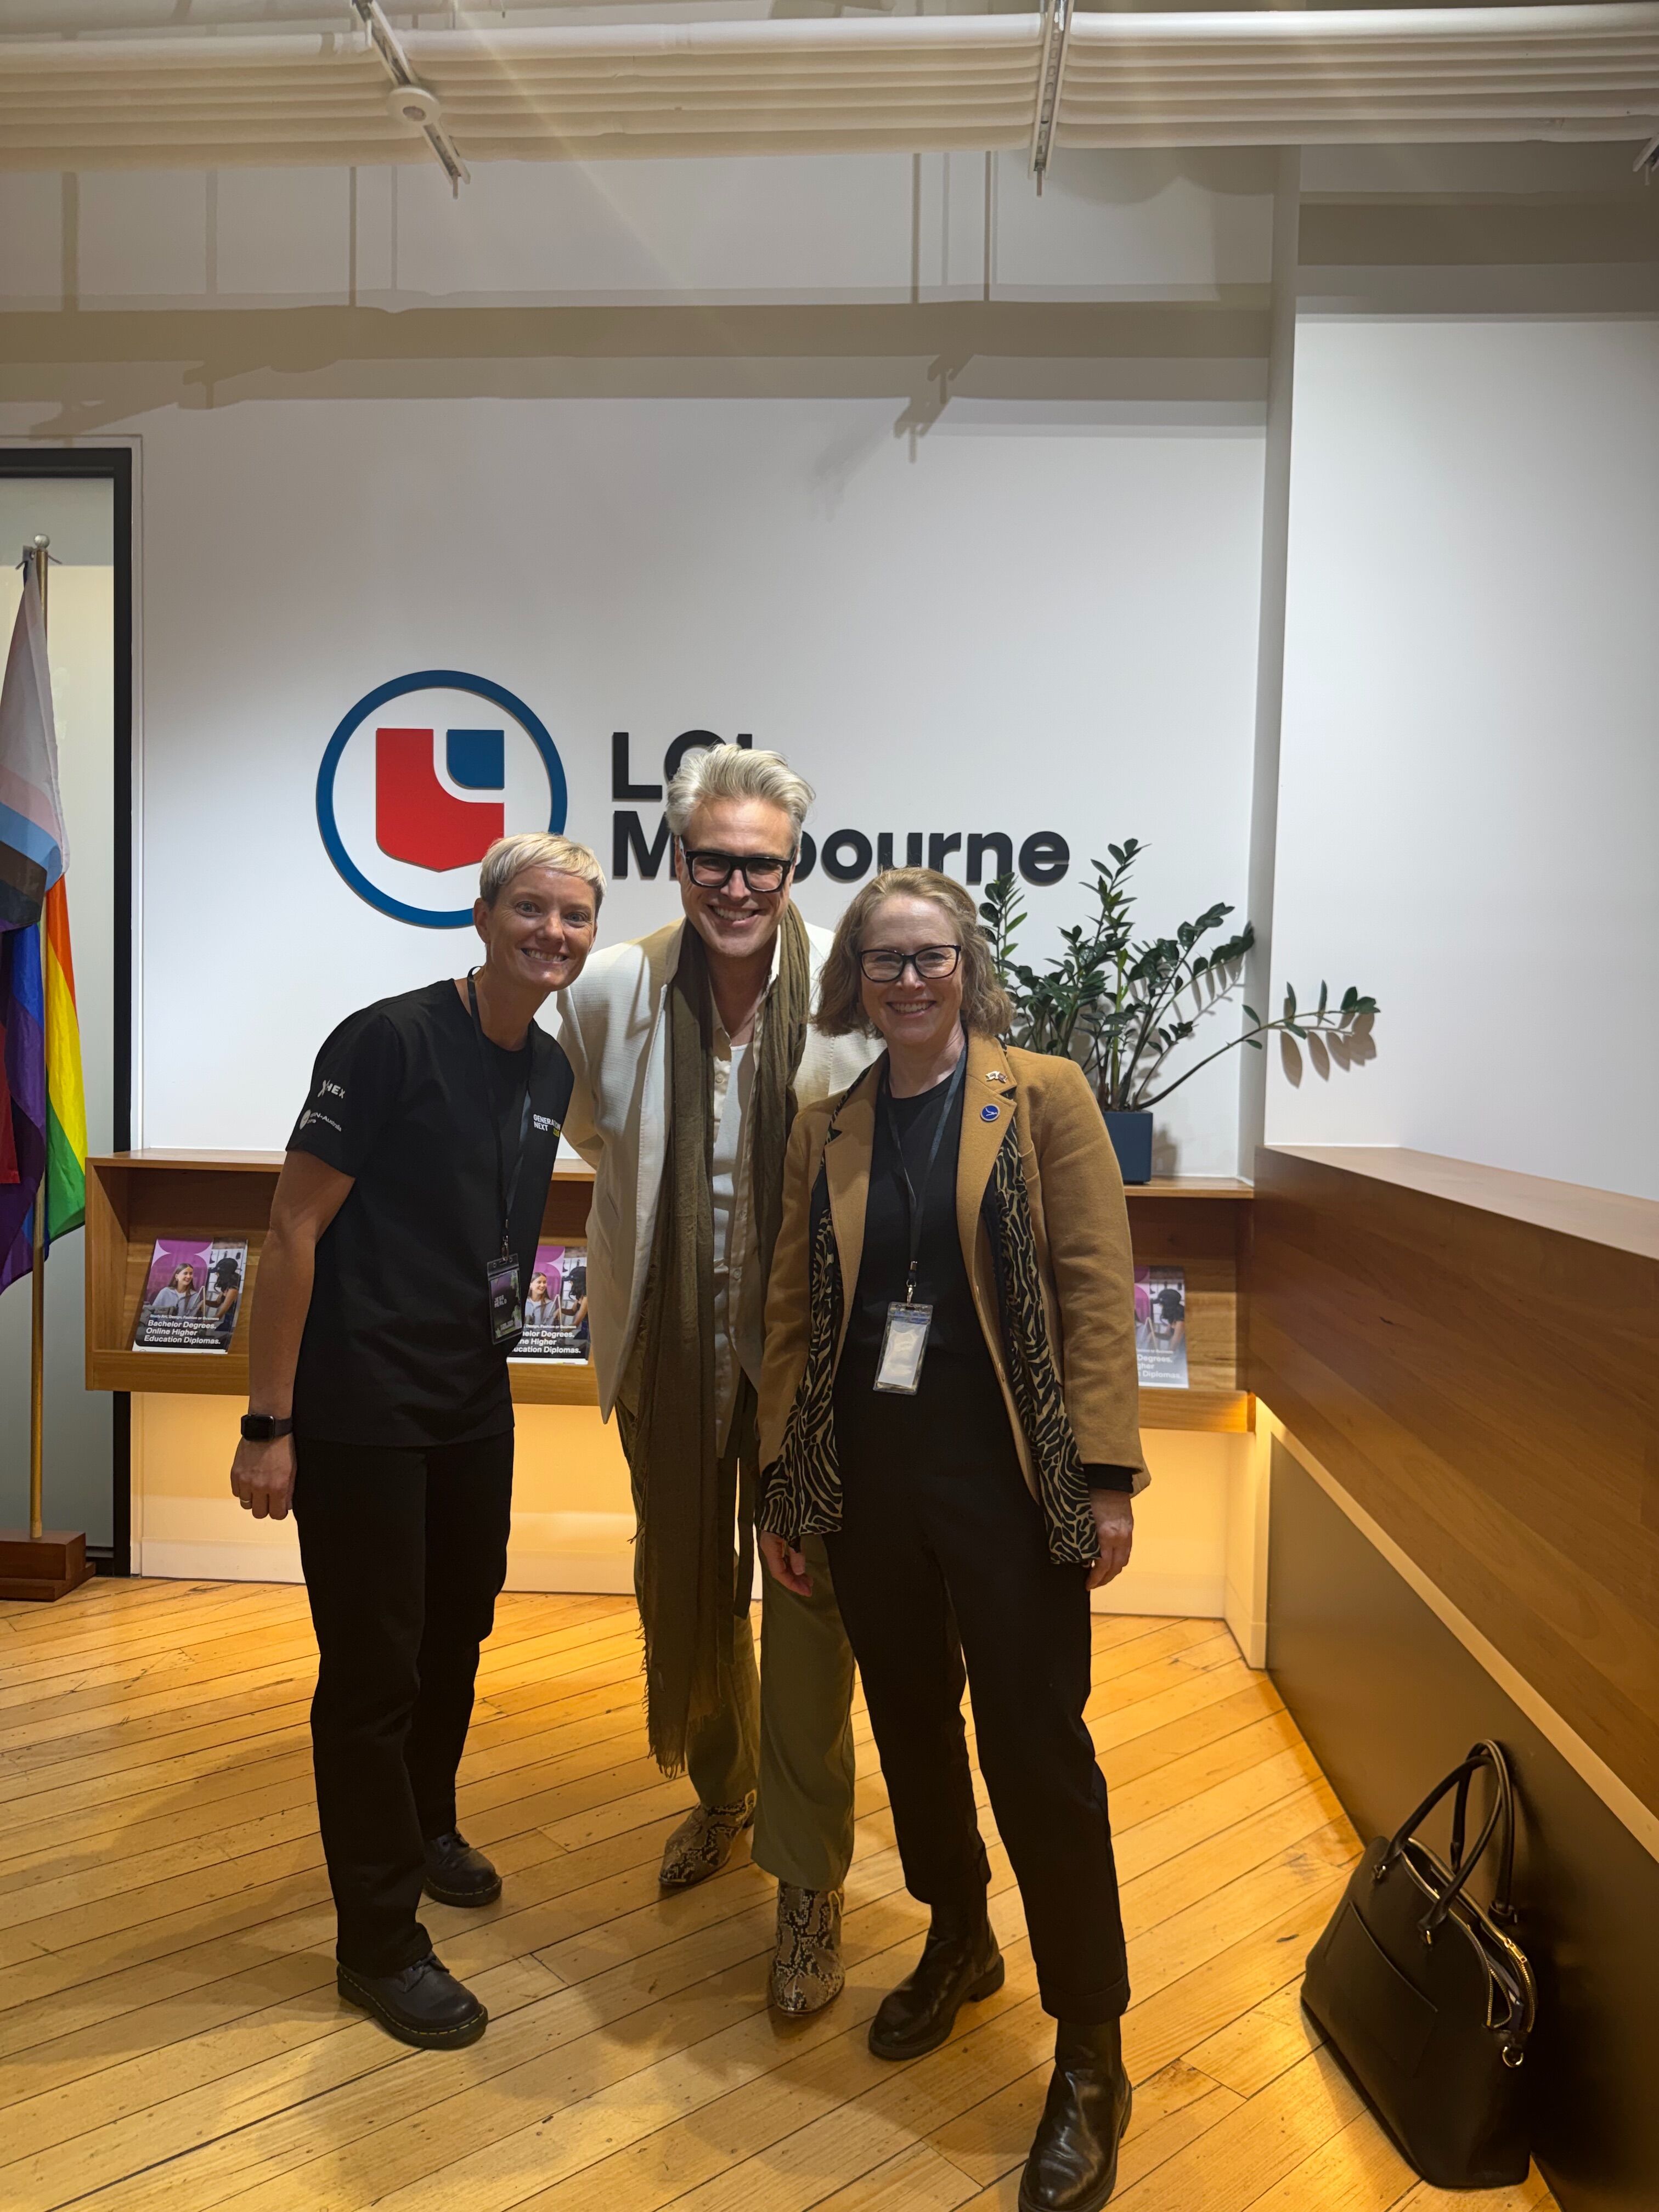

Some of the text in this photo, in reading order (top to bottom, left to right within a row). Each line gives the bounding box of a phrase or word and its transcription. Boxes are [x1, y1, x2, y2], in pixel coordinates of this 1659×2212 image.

[612, 730, 753, 799] LC
[613, 810, 1070, 884] Mourne
[534, 1121, 548, 1131] NEXT
[148, 1319, 217, 1329] Bachelor Degrees.
[541, 1330, 575, 1339] Degrees.
[144, 1335, 221, 1345] Education Diplomas.
[531, 1338, 557, 1346] Higher
[543, 1346, 581, 1355] Diplomas.
